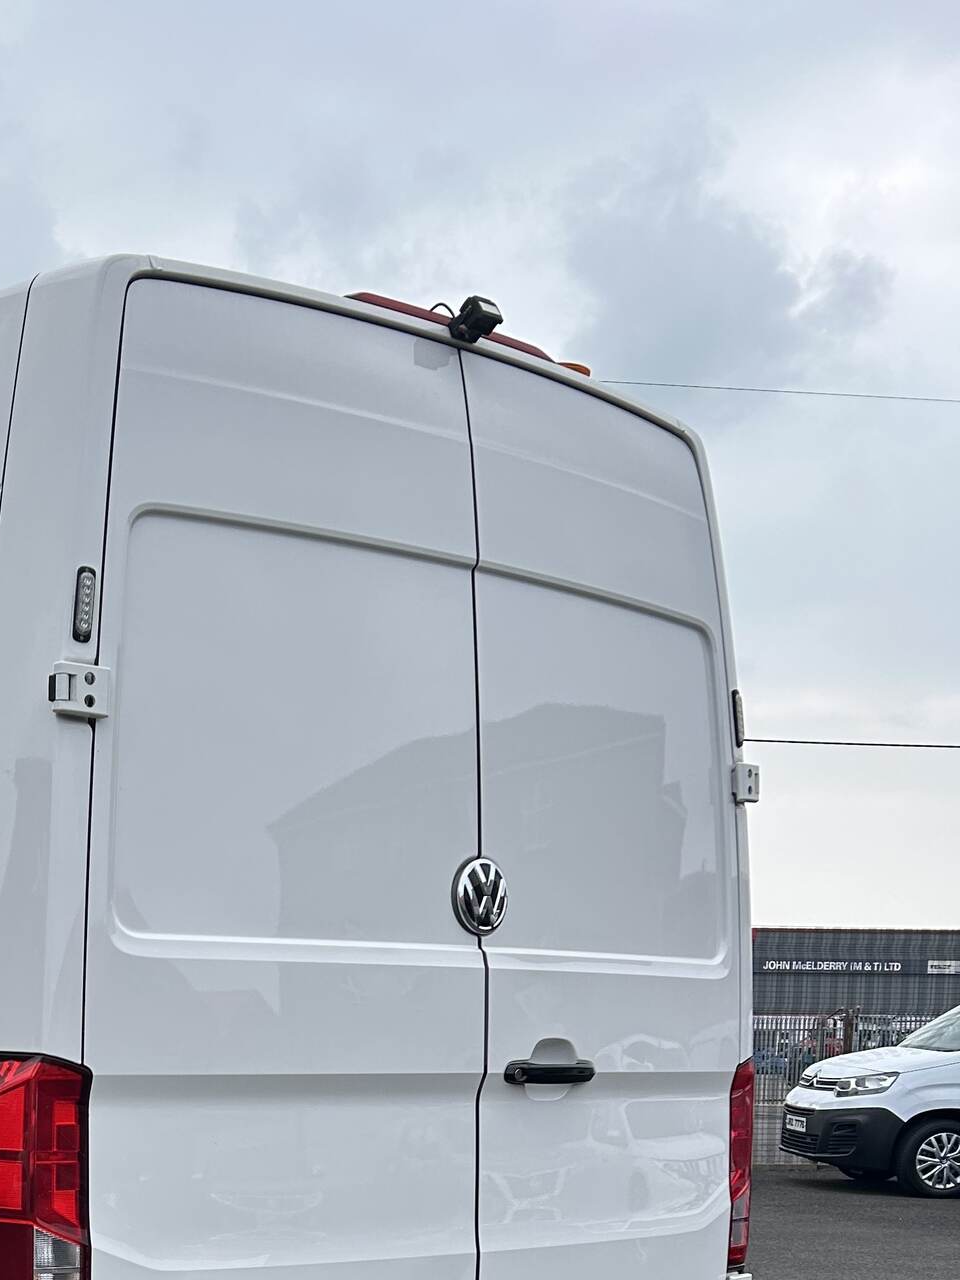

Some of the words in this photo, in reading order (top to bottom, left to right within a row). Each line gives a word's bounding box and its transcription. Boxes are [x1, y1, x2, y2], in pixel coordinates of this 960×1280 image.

[762, 960, 791, 970] JOHN
[792, 961, 848, 970] McELDERRY
[850, 961, 862, 971] (M
[864, 962, 872, 971] &
[884, 962, 901, 971] LTD
